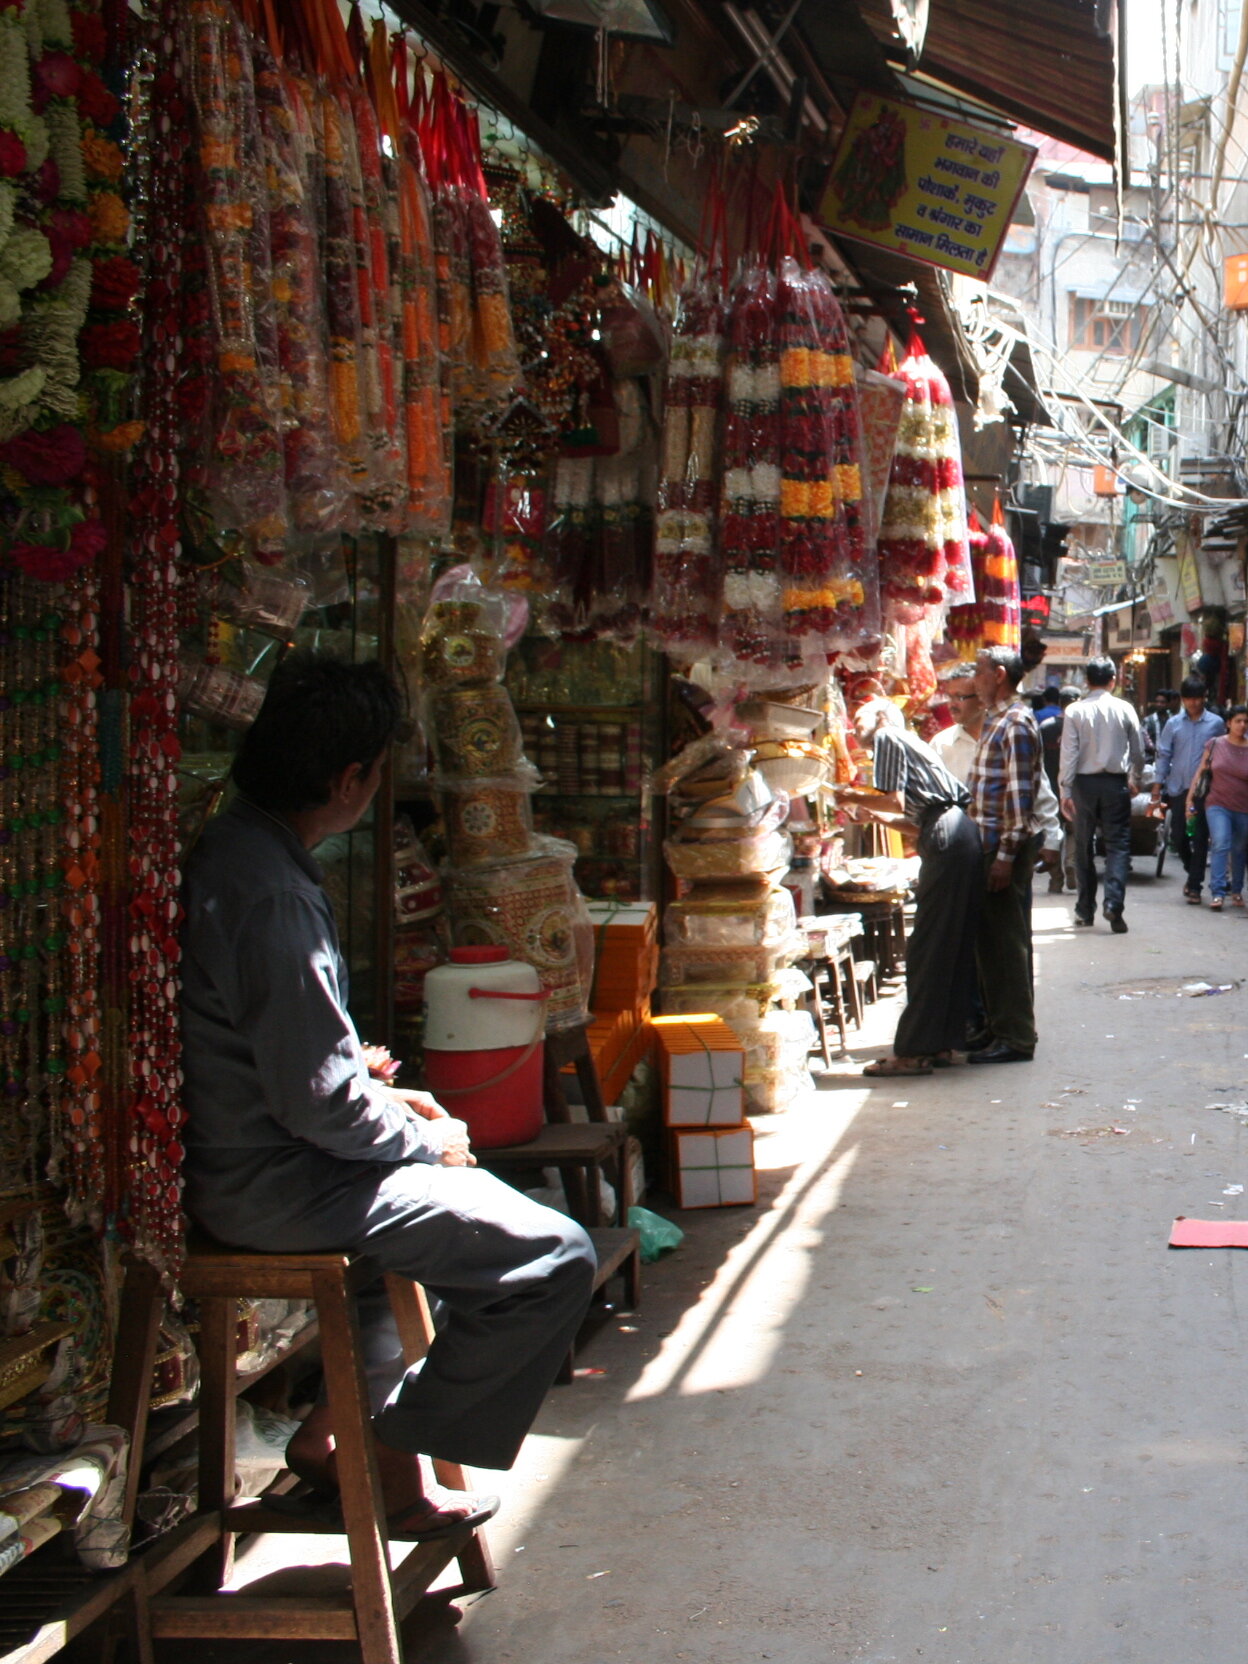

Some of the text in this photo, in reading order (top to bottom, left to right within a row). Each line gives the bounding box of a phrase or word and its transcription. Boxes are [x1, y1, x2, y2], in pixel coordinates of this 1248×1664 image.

[945, 133, 977, 153] हमारे
[935, 156, 1001, 190] भगवान की
[916, 205, 926, 218] व
[964, 218, 983, 237] का
[963, 193, 998, 218] मुकुट
[895, 223, 988, 267] सामान मिलता है
